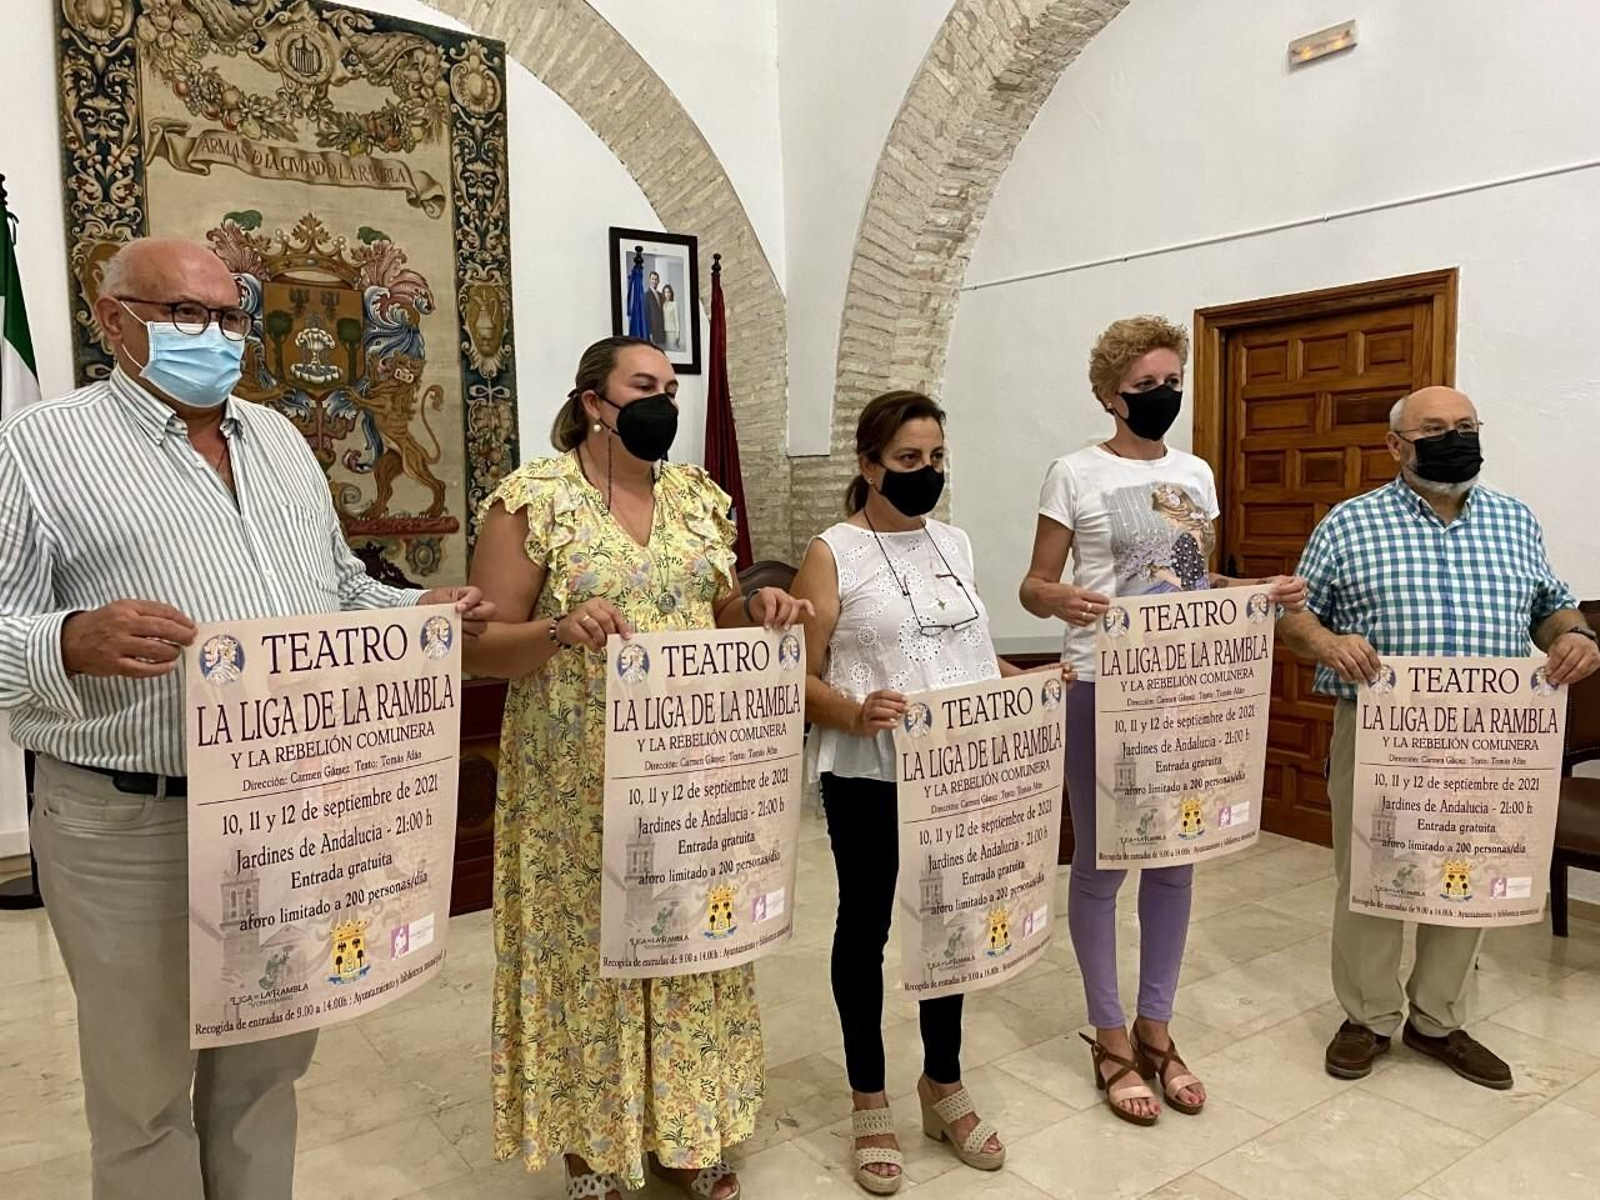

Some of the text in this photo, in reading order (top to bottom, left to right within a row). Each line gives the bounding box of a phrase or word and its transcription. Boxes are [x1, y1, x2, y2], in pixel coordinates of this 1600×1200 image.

[1140, 599, 1236, 632] TEATRO
[262, 624, 407, 674] TEATRO
[662, 640, 769, 677] TEATRO
[1102, 635, 1268, 676] LA LIGA DE LA RAMBLA
[1121, 681, 1127, 692] Y
[1131, 680, 1144, 691] LA
[1200, 668, 1254, 685] COMUNERA
[1408, 667, 1519, 694] TEATRO
[197, 675, 454, 746] LA LIGA DE LA RAMBLA
[613, 684, 800, 732] LA LIGA DE LA RAMBLA
[942, 687, 1033, 729] TEATRO
[1141, 722, 1147, 734] y
[1151, 717, 1159, 730] 12
[1163, 716, 1174, 728] de
[1226, 708, 1235, 721] de
[1363, 704, 1558, 734] LA LIGA DE LA RAMBLA
[231, 721, 435, 769] Y LA REBELIÓN COMUNERA
[637, 723, 786, 752] Y LA REBELIÓN COMUNERA
[902, 722, 1062, 781] LA LIGA DE LA RAMBLA
[1122, 740, 1158, 759] Jardines
[1161, 739, 1172, 753] de
[1176, 736, 1216, 751] Andalucia
[1383, 737, 1539, 750] Y LA REBELIÓN COMUNERA
[243, 776, 287, 791] Dirección:
[291, 770, 322, 784] Carmen
[924, 786, 931, 798] Y
[935, 784, 948, 797] LA
[1001, 760, 1050, 782] COMUNERA
[1156, 758, 1189, 773] Entrada
[629, 767, 789, 806] 10, 11 y 12 de septiembre de 2021
[1375, 773, 1539, 792] 10, 11 y 12 de septiembre de 2021
[222, 774, 438, 836] 10, 11 y 12 de septiembre de 2021
[1381, 796, 1421, 812] Jardines
[1425, 799, 1436, 812] de
[1440, 800, 1489, 814] Andalucia
[1500, 801, 1524, 814] 21:00
[638, 817, 681, 838] Jardines
[685, 814, 698, 829] de
[701, 807, 748, 828] Andalucia
[955, 823, 965, 838] 12
[967, 820, 978, 836] de
[1027, 807, 1035, 819] de
[1417, 818, 1496, 835] Entrada gratuita
[236, 809, 433, 874] Jardines de Andalucia 21:00 h
[678, 831, 755, 854] Entrada gratuita
[1408, 838, 1444, 853] limitado
[1456, 843, 1471, 853] 200
[291, 852, 392, 889] Entrada gratuita
[669, 864, 708, 882] limitado
[711, 867, 715, 876] a
[719, 861, 733, 875] 200
[929, 854, 964, 872] Jardines
[967, 849, 977, 862] de
[962, 868, 995, 886] Entrada
[240, 912, 275, 931] aforo
[280, 899, 331, 924] limitado
[335, 900, 341, 910] a
[346, 889, 364, 908] 200
[195, 1019, 234, 1036] Recogida
[236, 1016, 246, 1030] de
[285, 1008, 294, 1020] de
